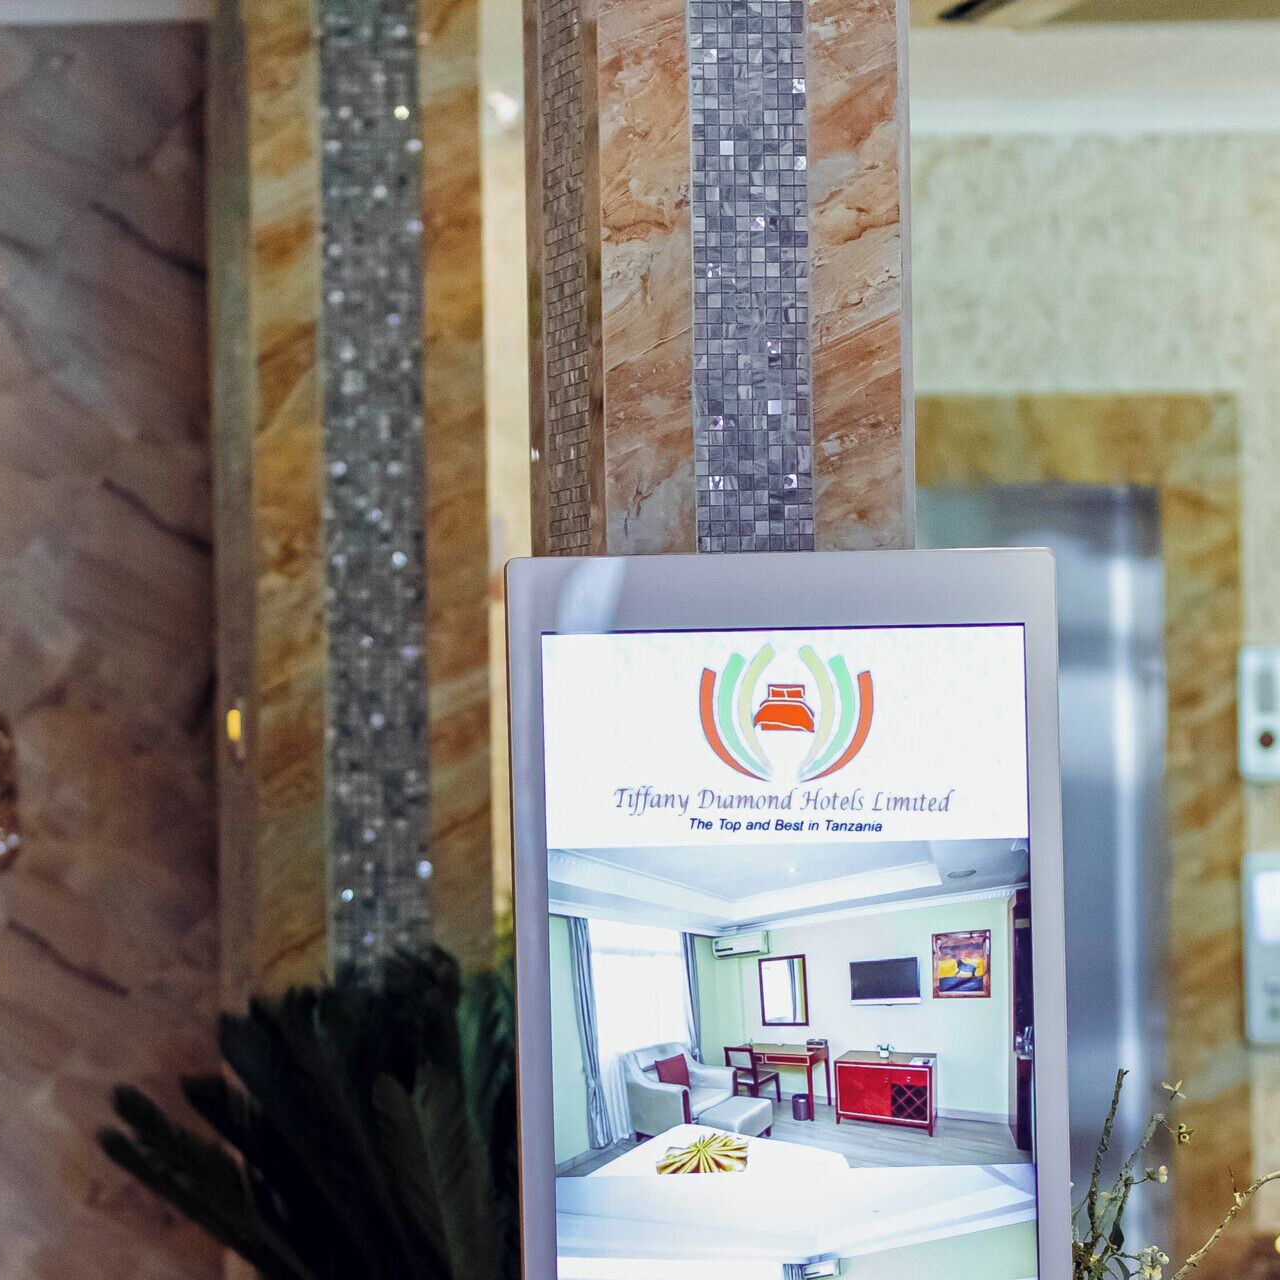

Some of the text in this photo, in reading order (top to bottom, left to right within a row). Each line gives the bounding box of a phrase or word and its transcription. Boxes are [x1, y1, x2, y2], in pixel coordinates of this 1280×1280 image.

[614, 785, 955, 816] Tiffany Diamond Hotels Limited
[689, 817, 883, 832] The Top and Best in Tanzania
